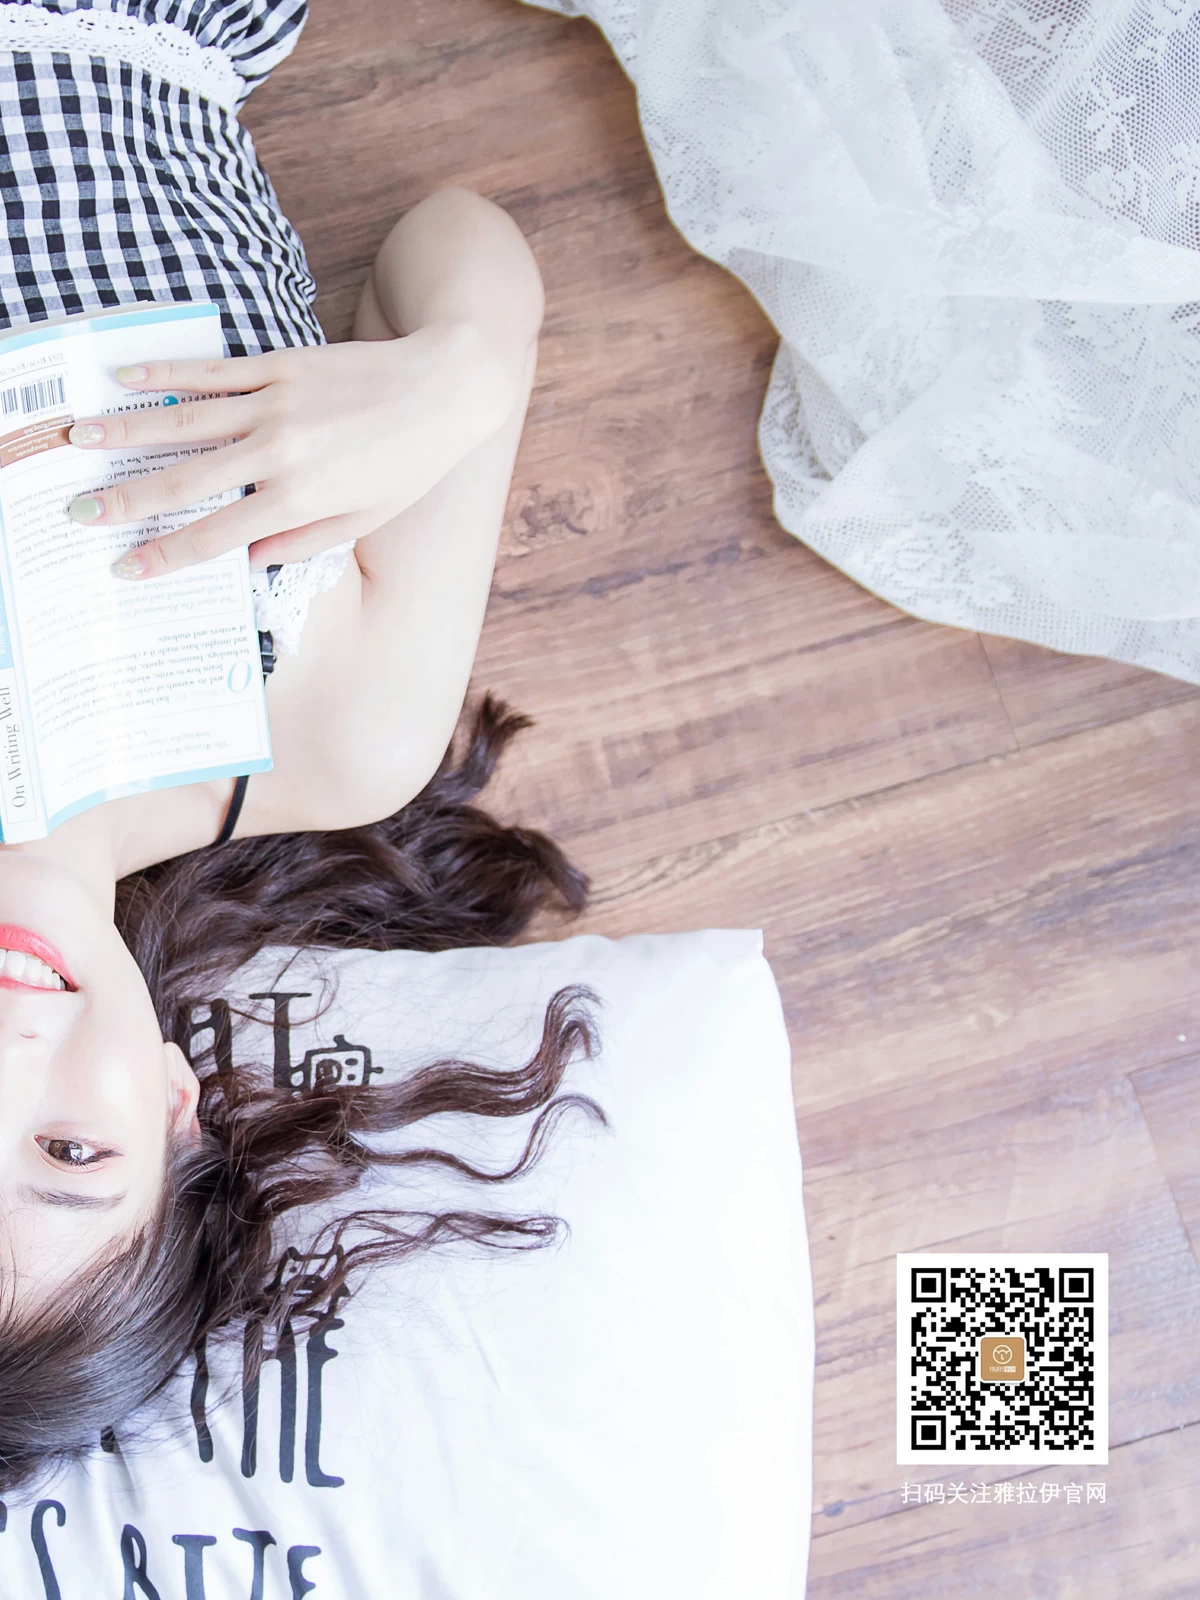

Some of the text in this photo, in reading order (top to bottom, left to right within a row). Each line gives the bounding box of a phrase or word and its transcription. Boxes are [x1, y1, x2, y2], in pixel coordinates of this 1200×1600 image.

[99, 391, 220, 415] HARPER PERENNIAL
[141, 447, 179, 464] hometown,
[179, 447, 190, 457] his
[190, 447, 199, 455] in
[109, 458, 124, 468] York
[125, 455, 141, 466] New
[126, 465, 151, 478] School
[150, 463, 165, 473] New
[111, 470, 126, 481] and
[120, 526, 144, 539] Herald
[143, 524, 160, 535] York
[159, 522, 175, 532] New
[154, 622, 246, 646] of writers and students.
[232, 634, 248, 645] and
[179, 641, 199, 653] have
[199, 634, 232, 651] insights
[156, 644, 179, 656] made
[204, 644, 249, 662] technology,
[124, 663, 137, 673] the
[137, 657, 165, 671] sports,
[202, 662, 223, 674] learn
[151, 669, 174, 682] write,
[184, 666, 202, 677] how
[196, 676, 207, 686] its
[208, 673, 224, 684] and
[155, 683, 165, 694] of
[165, 678, 195, 692] warmth
[0, 722, 27, 780] Writing
[9, 784, 27, 808] On
